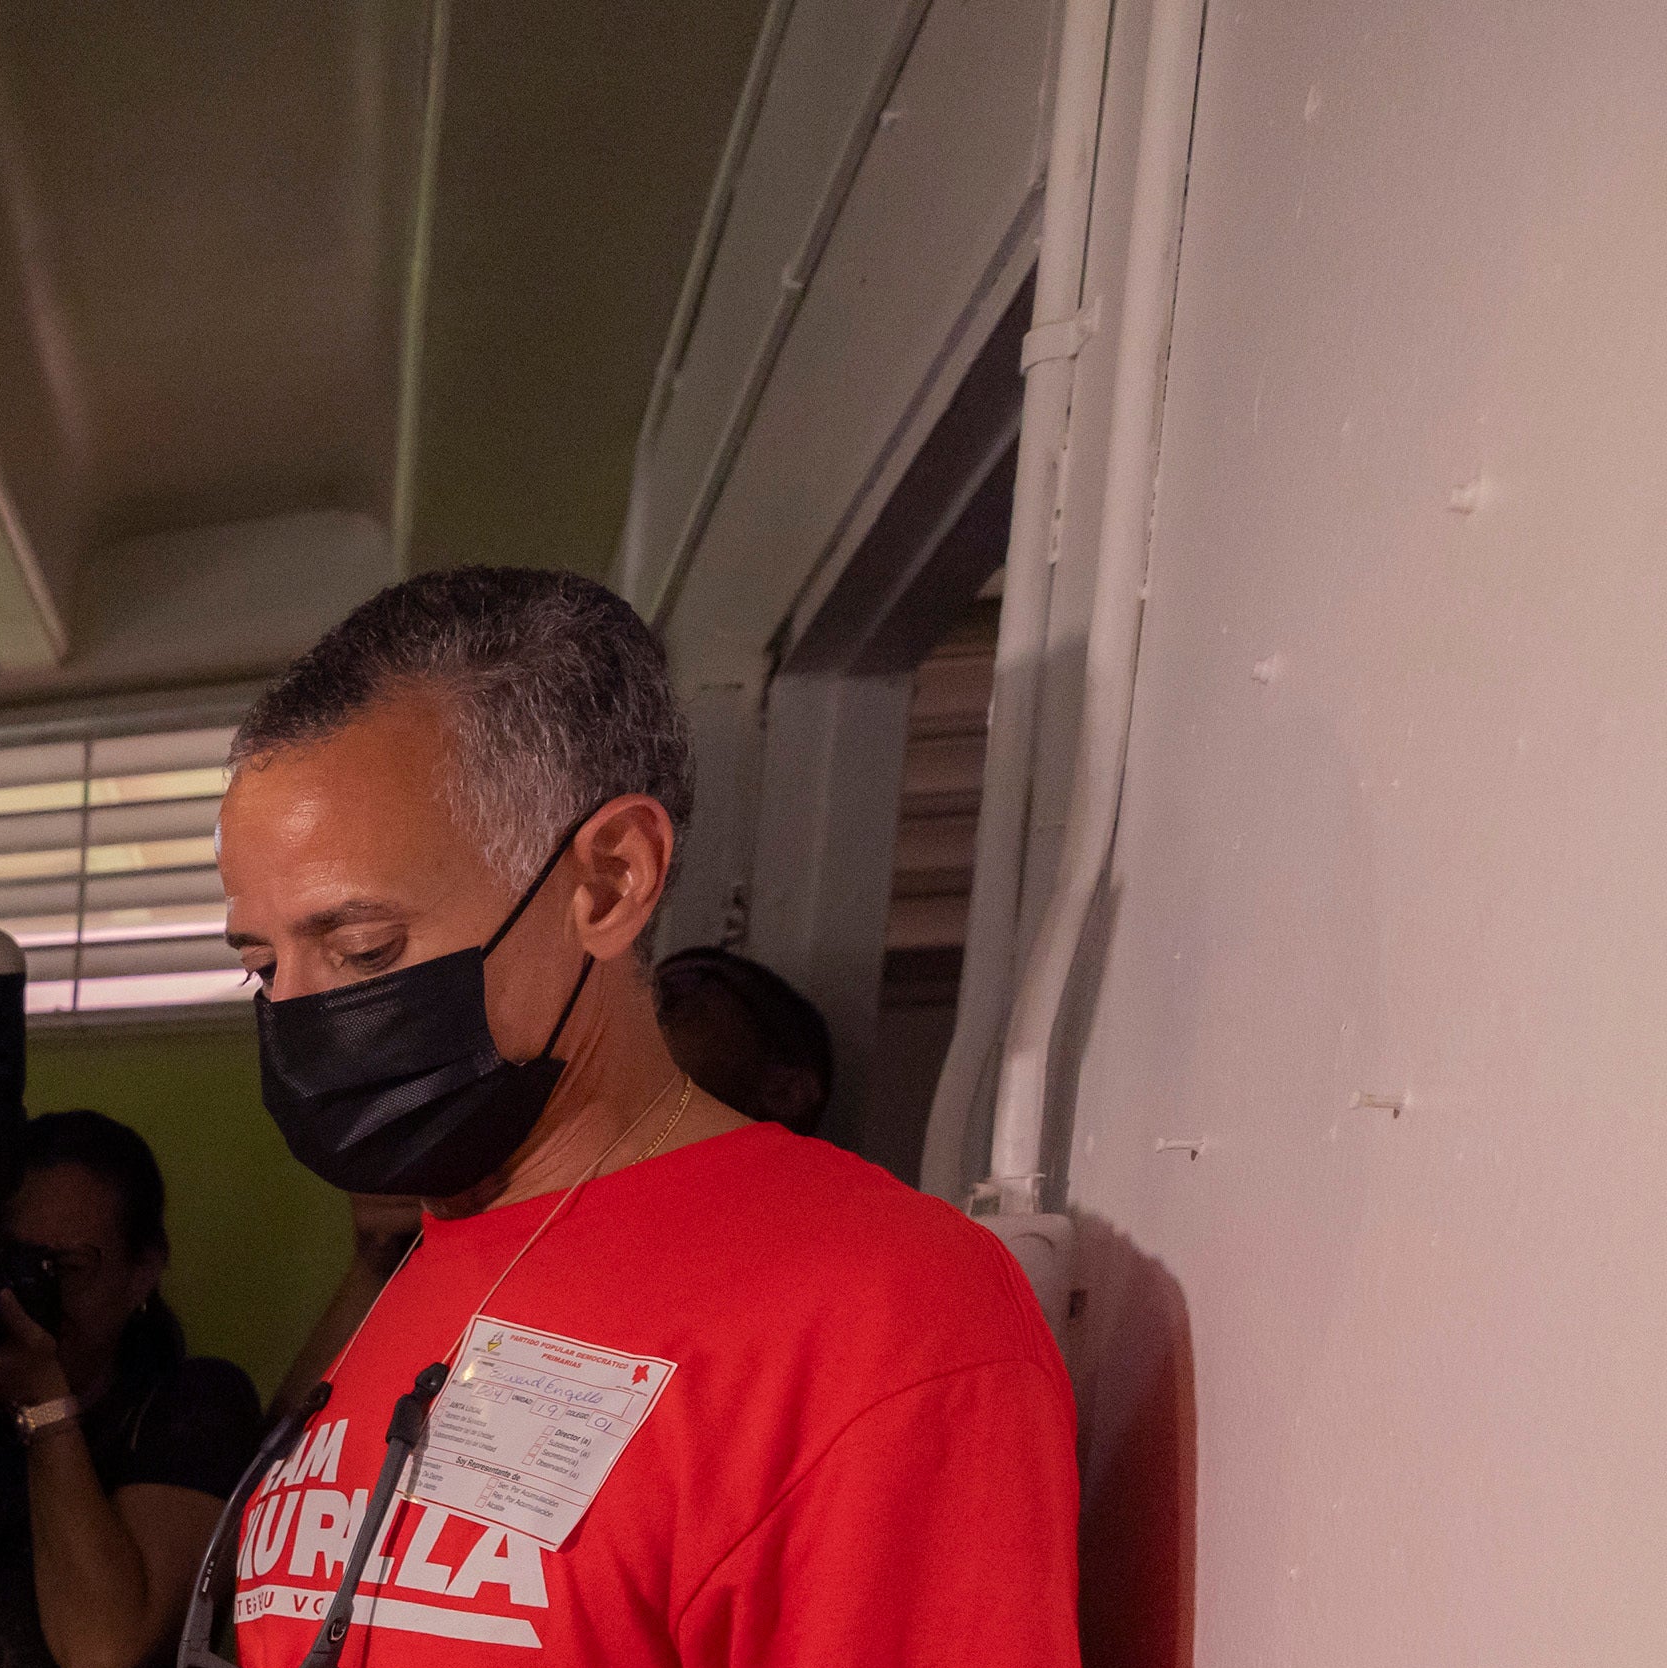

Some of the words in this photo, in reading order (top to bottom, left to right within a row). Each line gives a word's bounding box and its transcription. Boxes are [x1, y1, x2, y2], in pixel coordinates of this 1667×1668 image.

[510, 1334, 541, 1347] PARTIDO
[540, 1342, 575, 1357] POPULAR
[541, 1353, 583, 1369] PRIMARIAS
[554, 1428, 580, 1443] Director
[455, 1456, 467, 1468] Soy
[467, 1459, 512, 1479] Representante
[511, 1472, 521, 1481] de
